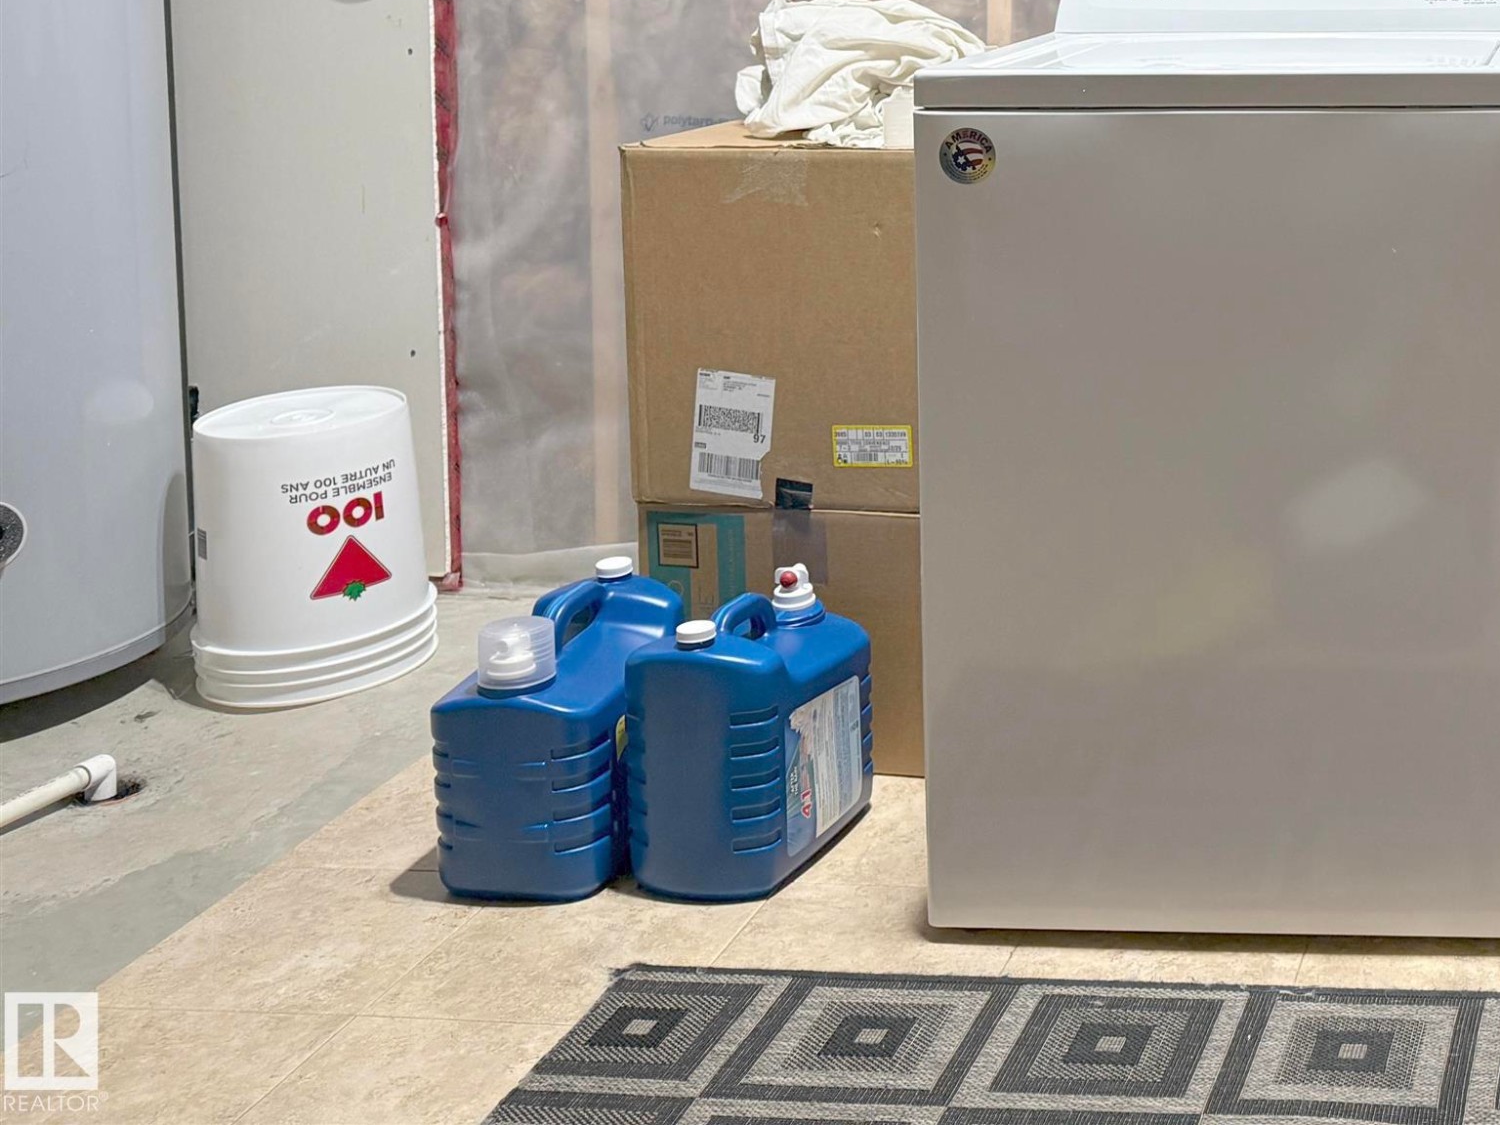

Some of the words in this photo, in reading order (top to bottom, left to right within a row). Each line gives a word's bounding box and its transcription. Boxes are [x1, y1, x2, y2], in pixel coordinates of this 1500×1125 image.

[945, 130, 993, 154] AMERICA
[753, 434, 767, 444] 97
[382, 459, 396, 471] UN
[341, 464, 380, 484] AUTRE
[281, 481, 310, 494] ANS
[314, 477, 337, 489] 100
[332, 472, 392, 498] ENSEMBLE
[289, 489, 328, 504] POUR
[307, 491, 384, 536] 100
